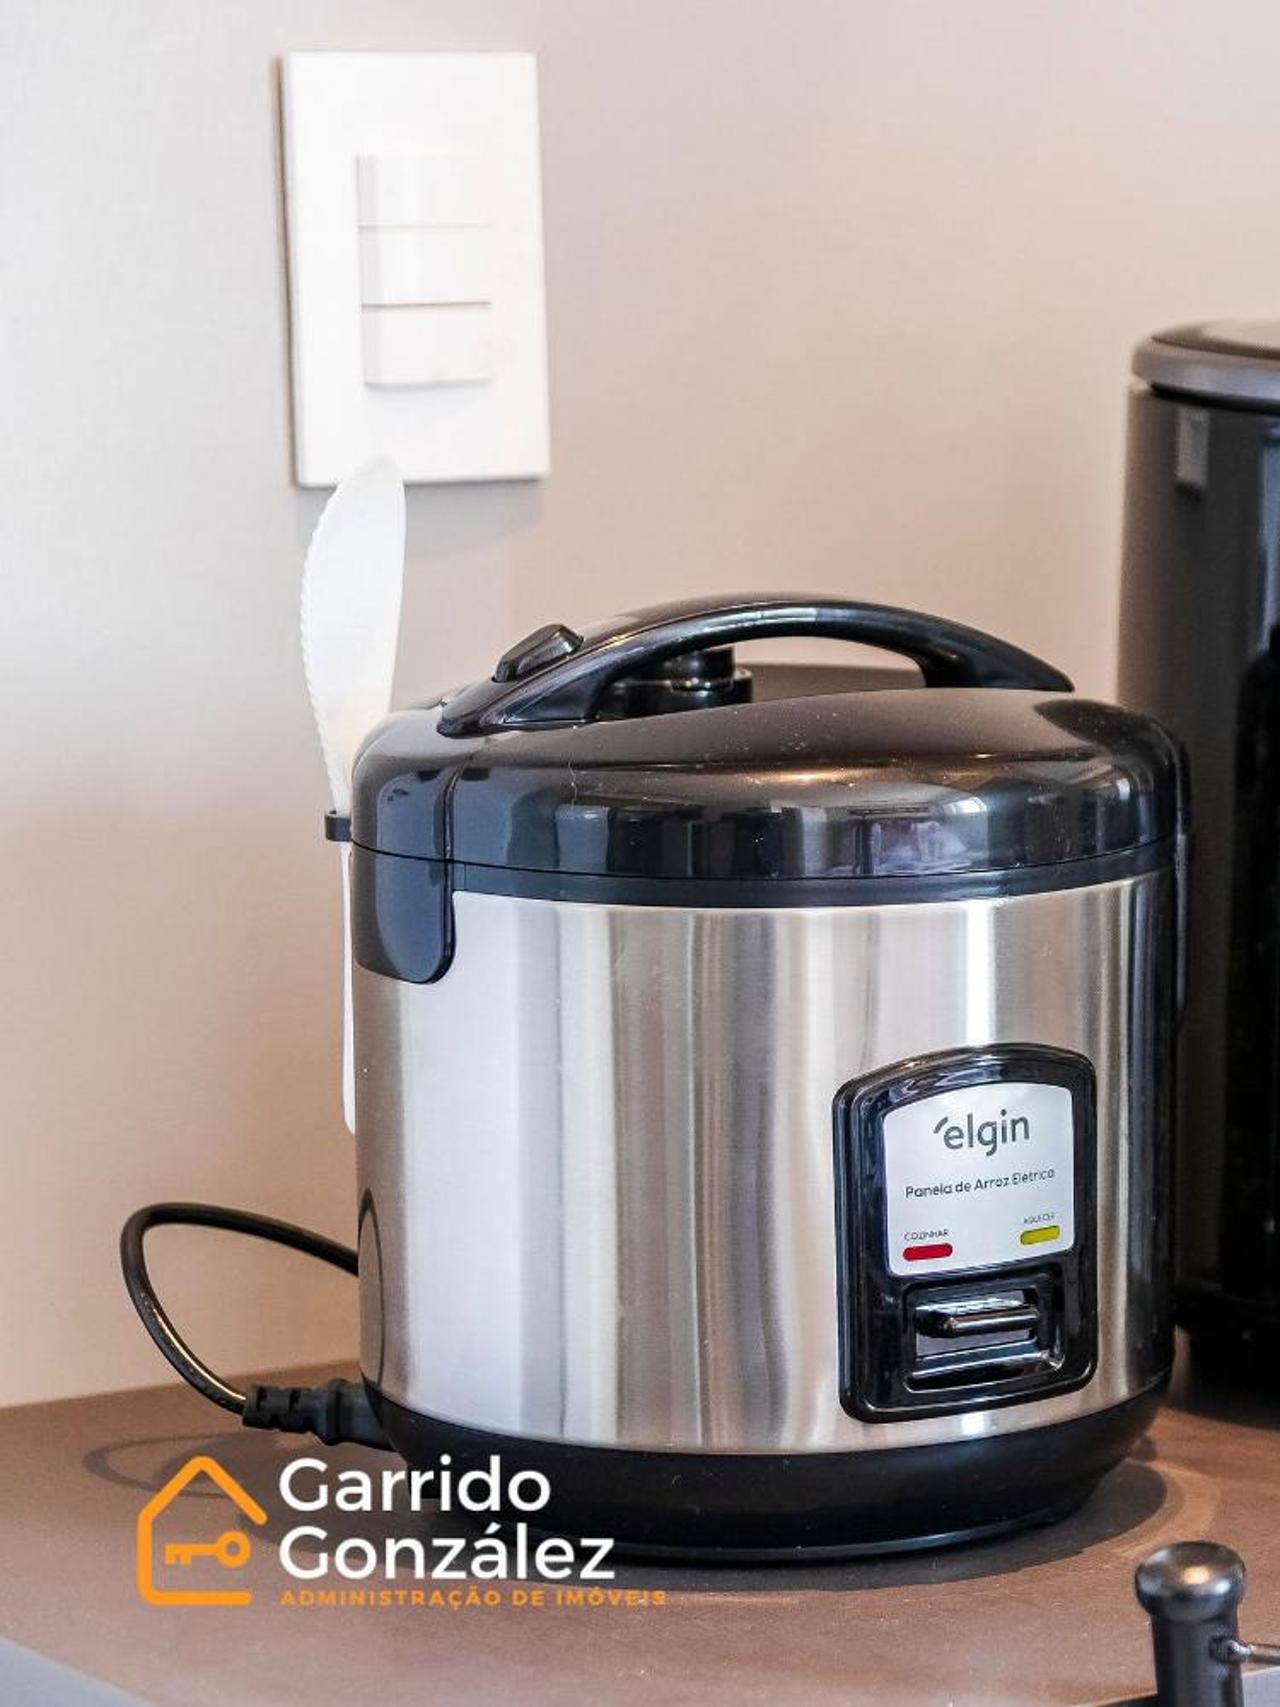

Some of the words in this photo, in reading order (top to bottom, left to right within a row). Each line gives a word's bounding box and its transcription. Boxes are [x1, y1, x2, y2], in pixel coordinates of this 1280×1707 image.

[941, 1109, 1030, 1157] elgin
[905, 1184, 952, 1199] Panela
[954, 1181, 972, 1193] de
[973, 1177, 1009, 1191] Arroz
